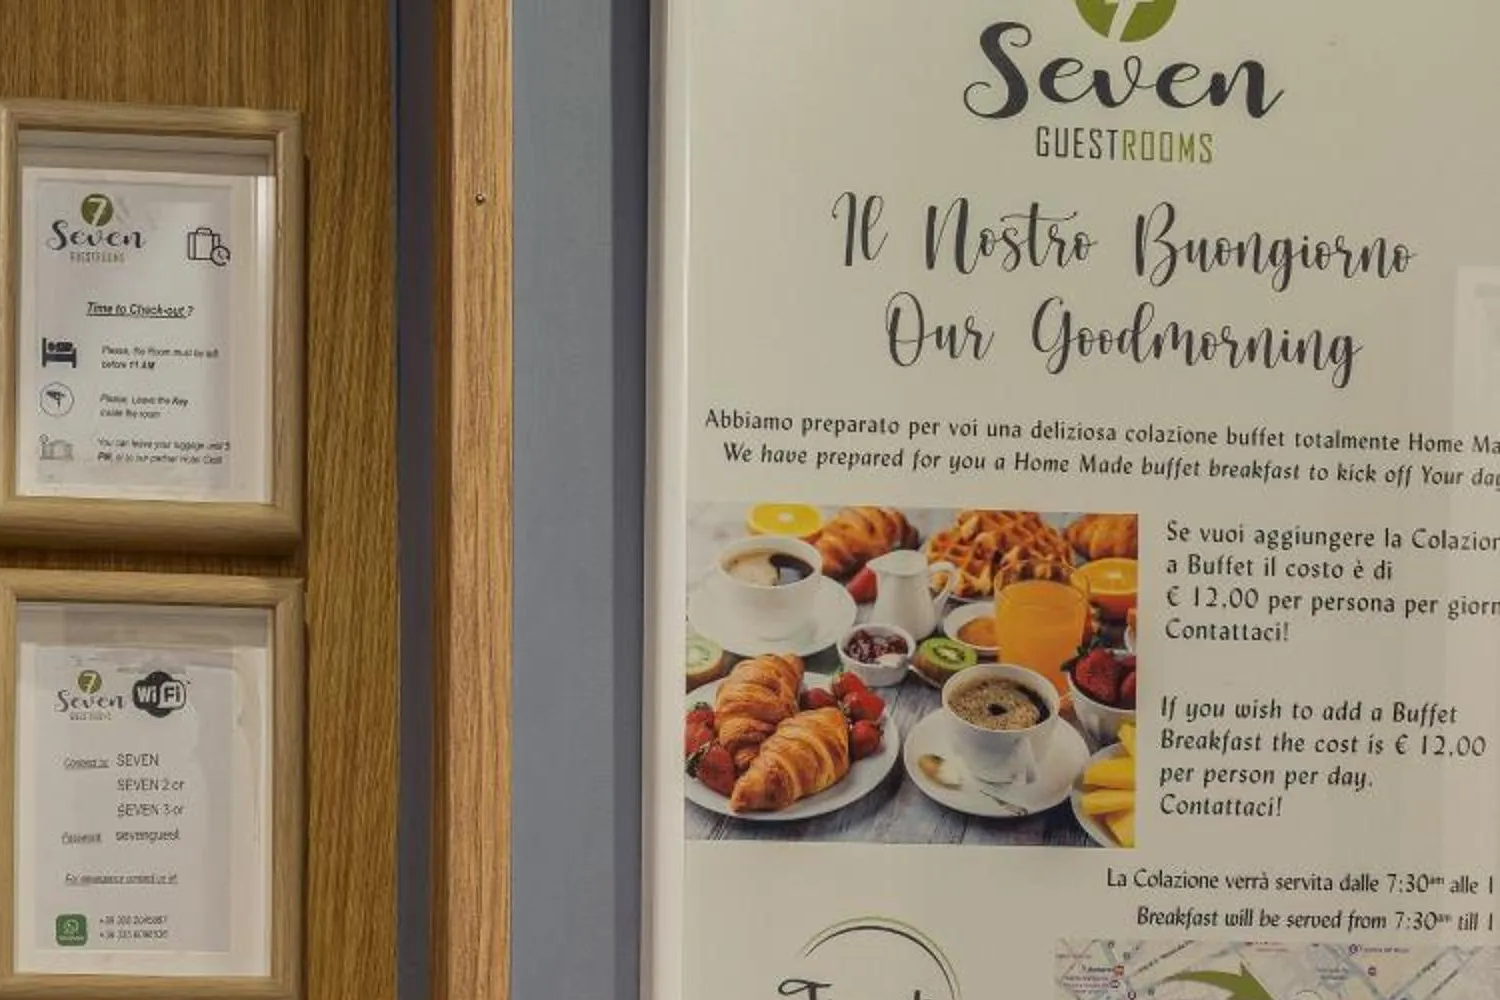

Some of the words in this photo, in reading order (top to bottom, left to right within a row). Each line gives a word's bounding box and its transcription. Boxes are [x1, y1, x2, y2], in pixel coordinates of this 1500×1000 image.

[963, 21, 1284, 120] Seven
[1036, 126, 1212, 164] GUESTROOMS
[46, 220, 146, 250] Seven
[926, 198, 1098, 275] Nostro
[1135, 202, 1416, 292] Buongiorno
[87, 302, 112, 314] Time
[116, 304, 126, 313] to
[886, 292, 994, 367] Our
[1032, 296, 1363, 388] Goodmorning
[705, 409, 792, 430] Abbiamo
[802, 418, 900, 438] preparato
[909, 421, 940, 440] per
[949, 418, 978, 436] voi
[987, 424, 1022, 438] una
[1031, 420, 1116, 441] deliziosa
[1126, 424, 1218, 445] colazione
[1226, 426, 1284, 447] buffet
[1295, 430, 1400, 451] totalmente
[1409, 432, 1463, 452] Home
[724, 442, 752, 463] We
[761, 443, 807, 464] have
[816, 448, 904, 471] prepared
[913, 449, 942, 471] for
[949, 456, 986, 474] you
[994, 457, 1005, 470] a
[1014, 452, 1069, 472] Home
[1080, 454, 1132, 474] Made
[1141, 456, 1200, 480] buffet
[1209, 458, 1299, 484] breakfast
[1309, 464, 1328, 480] to
[1337, 463, 1376, 483] kick
[1384, 464, 1412, 488] off
[1422, 465, 1464, 485] Your
[1167, 520, 1191, 542] Se
[1200, 524, 1244, 543] vuoi
[1254, 526, 1374, 552] aggiungere
[1385, 528, 1402, 548] la
[1166, 560, 1177, 574] a
[1188, 554, 1253, 576] Buffet
[1264, 556, 1276, 576] il
[1286, 562, 1344, 579] costo
[1353, 559, 1364, 579] è
[1374, 560, 1392, 580] di
[1167, 586, 1180, 607] €
[1268, 595, 1302, 615] per
[1312, 596, 1395, 616] persona
[1405, 599, 1439, 619] per
[1165, 618, 1288, 642] Contattaci!
[54, 689, 126, 712] Seven
[1162, 696, 1177, 721] If
[1186, 703, 1225, 723] you
[1235, 698, 1281, 719] wish
[1292, 703, 1313, 720] to
[1322, 700, 1362, 721] add
[1371, 708, 1383, 722] a
[1393, 702, 1457, 728] Buffet
[1161, 728, 1261, 755] Breakfast
[1273, 732, 1304, 752] the
[1314, 736, 1358, 754] cost
[1368, 734, 1384, 755] is
[1395, 734, 1408, 755] €
[116, 753, 159, 767] SEVEN
[117, 778, 159, 791] SEVEN
[1160, 768, 1194, 787] per
[1204, 768, 1274, 789] person
[1284, 770, 1319, 791] per
[1328, 765, 1372, 792] day.
[117, 803, 159, 817] SEVEN
[1160, 793, 1283, 816] Contattaci!
[1107, 868, 1127, 887] La
[1134, 868, 1219, 889] Colazione
[1225, 872, 1269, 890] verrà
[1276, 873, 1333, 891] servita
[1340, 873, 1379, 892] dalle
[1450, 875, 1479, 894] alle
[1137, 905, 1219, 930] Breakfast
[1225, 908, 1254, 926] will
[1259, 908, 1280, 927] be
[1286, 910, 1342, 928] served
[1348, 910, 1386, 932] from
[1458, 912, 1478, 931] till
